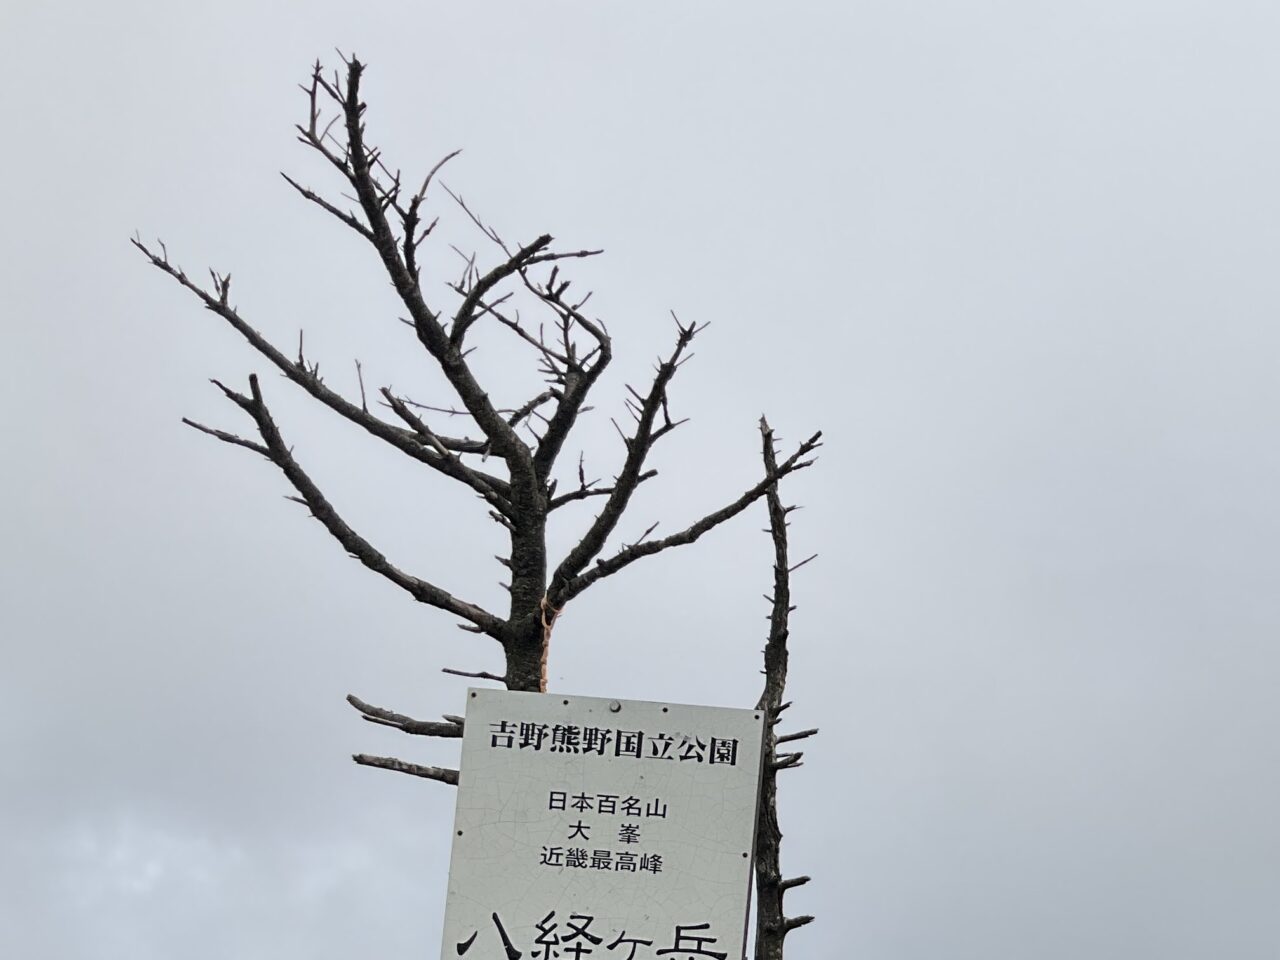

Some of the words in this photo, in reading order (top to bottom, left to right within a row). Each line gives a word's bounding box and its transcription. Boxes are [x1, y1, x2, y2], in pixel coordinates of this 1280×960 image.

[489, 720, 740, 767] 吉野熊野国立公園
[548, 790, 669, 819] 日本百名山
[539, 845, 664, 875] 近畿最高峰
